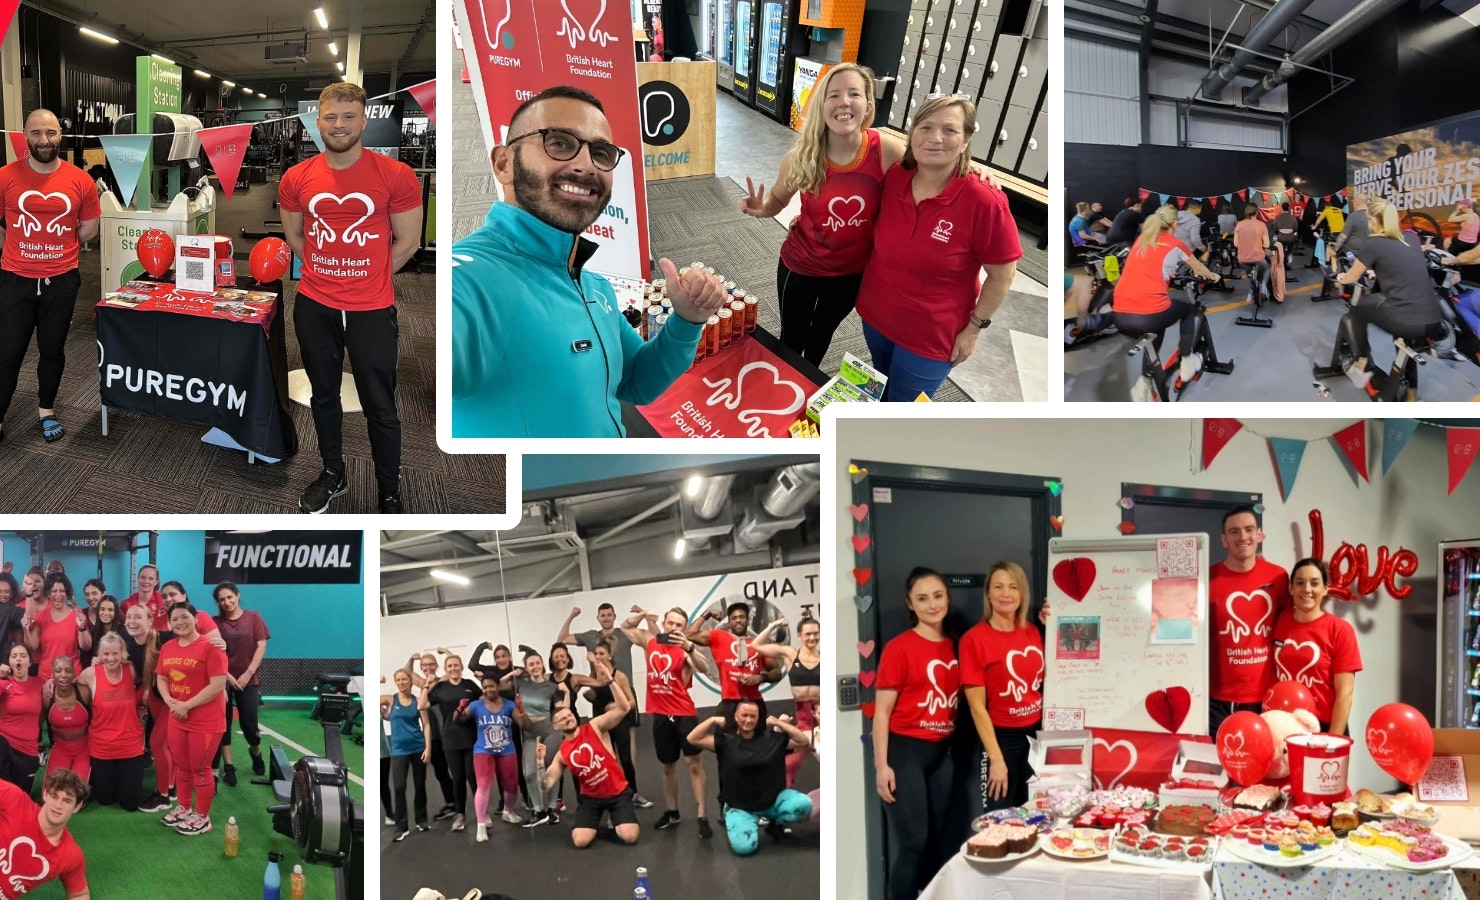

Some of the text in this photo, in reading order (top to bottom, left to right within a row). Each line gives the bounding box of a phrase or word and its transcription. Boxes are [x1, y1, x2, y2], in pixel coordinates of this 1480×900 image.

[489, 55, 521, 67] PUREGYM
[566, 54, 613, 69] British Heart
[151, 62, 181, 90] Cleaning
[570, 67, 612, 79] Foundation
[153, 86, 177, 107] Station
[644, 151, 691, 168] ELCOME
[1354, 148, 1437, 185] BRING YOUR
[1397, 167, 1440, 193] YOUR
[19, 242, 42, 251] British
[21, 251, 64, 260] Foundation
[311, 253, 370, 267] British Heart
[313, 264, 368, 277] Foundation
[106, 364, 247, 418] PUREGYM
[680, 400, 712, 432] British
[216, 545, 352, 569] FUNCTIONAL
[980, 751, 989, 809] PUREGYM
